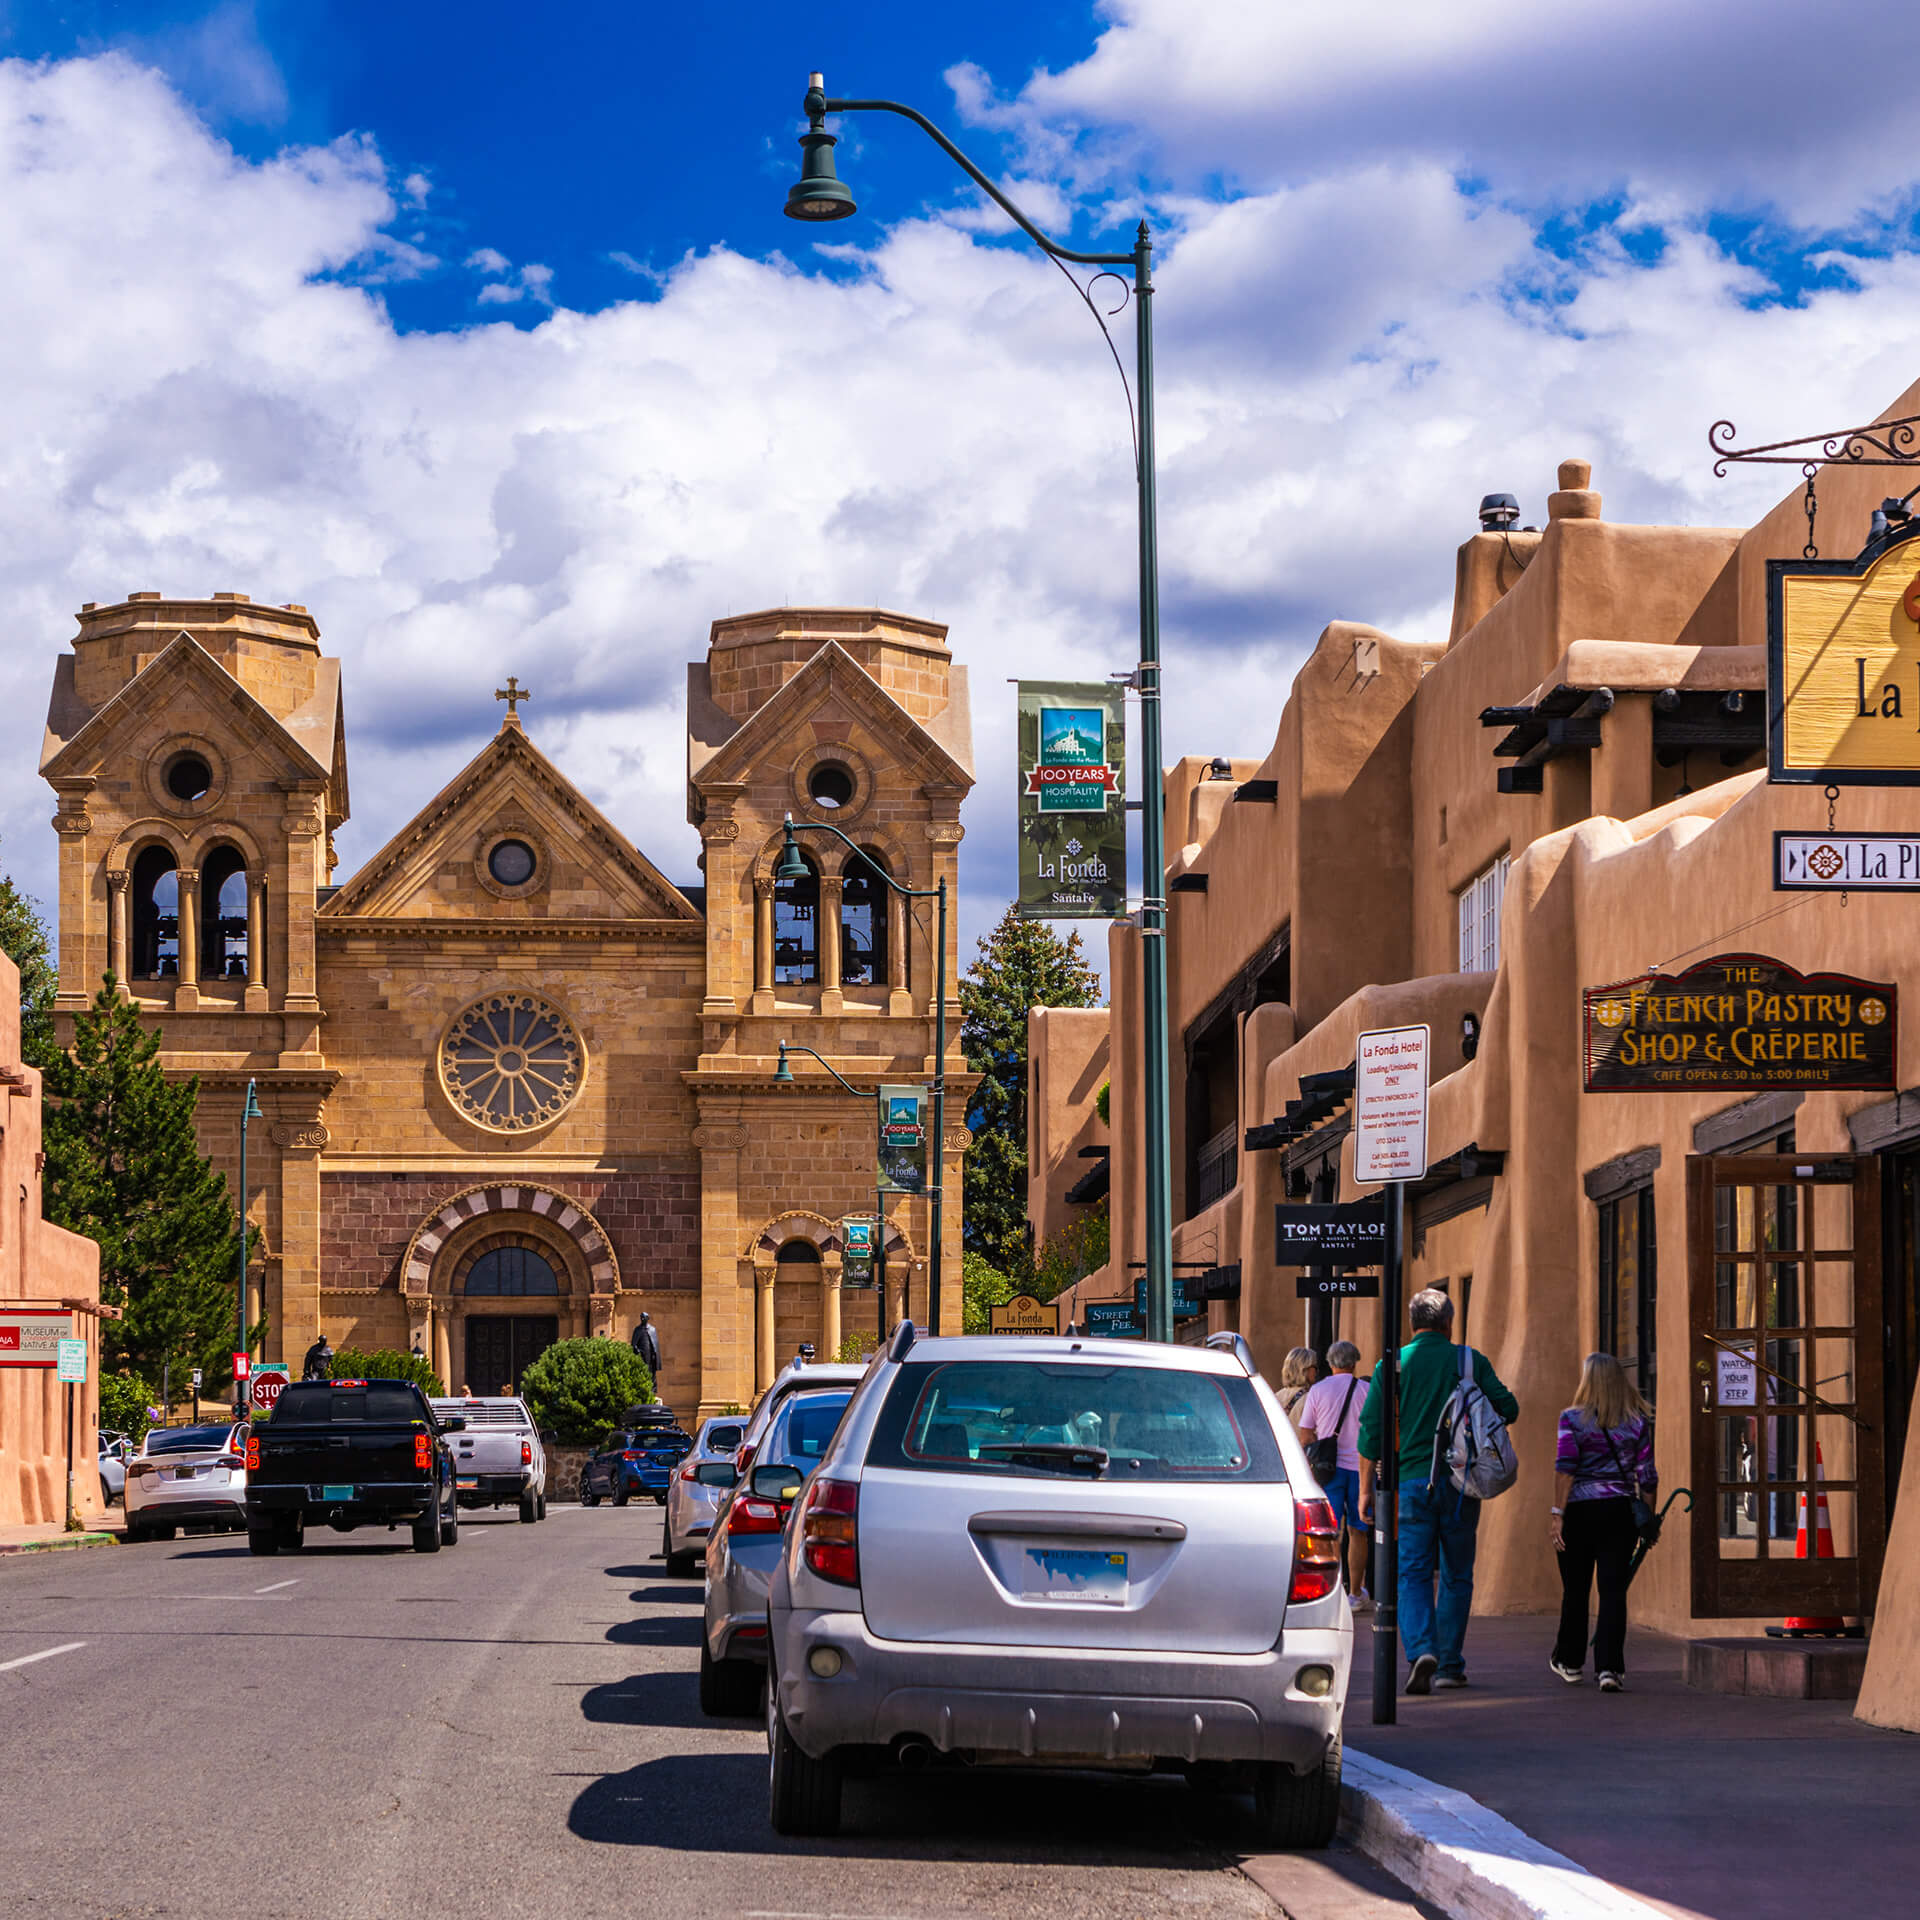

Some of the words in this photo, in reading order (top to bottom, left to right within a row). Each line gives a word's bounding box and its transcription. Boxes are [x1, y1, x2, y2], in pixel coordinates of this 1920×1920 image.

[1855, 657, 1903, 718] La
[1067, 769, 1105, 780] YEARS
[1045, 787, 1099, 796] HOSPITALITY
[1860, 843, 1888, 879] La
[1038, 853, 1055, 878] La
[1060, 853, 1107, 883] Fonda
[1723, 967, 1761, 983] THE
[1629, 989, 1735, 1028] FRENCH
[1746, 989, 1852, 1028] PASTRY
[1363, 1047, 1373, 1058] La
[1374, 1043, 1399, 1057] Fonda
[1401, 1039, 1423, 1053] Hotel
[1619, 1029, 1697, 1066] SHOP
[1704, 1033, 1726, 1063] &
[1384, 1076, 1400, 1086] ONLY
[1654, 1070, 1682, 1081] CAFE
[1685, 1070, 1718, 1081] OPEN
[1721, 1069, 1748, 1080] 6:30
[1750, 1070, 1763, 1080] to
[1767, 1069, 1793, 1080] 5:00
[1796, 1069, 1830, 1081] DAILY
[885, 1163, 894, 1175] La
[895, 1164, 918, 1178] Fonda
[1283, 1224, 1321, 1238] TOM
[1319, 1282, 1357, 1292] OPEN
[1006, 1311, 1016, 1324] La
[1017, 1311, 1043, 1327] Fonda
[1092, 1309, 1131, 1321] STREET
[1111, 1319, 1136, 1331] FEE
[21, 1328, 59, 1337] MUSEUM
[21, 1341, 48, 1349] NATIVE
[1721, 1360, 1752, 1368] WATCH
[1725, 1374, 1749, 1383] YOUR
[1725, 1389, 1748, 1399] STEP
